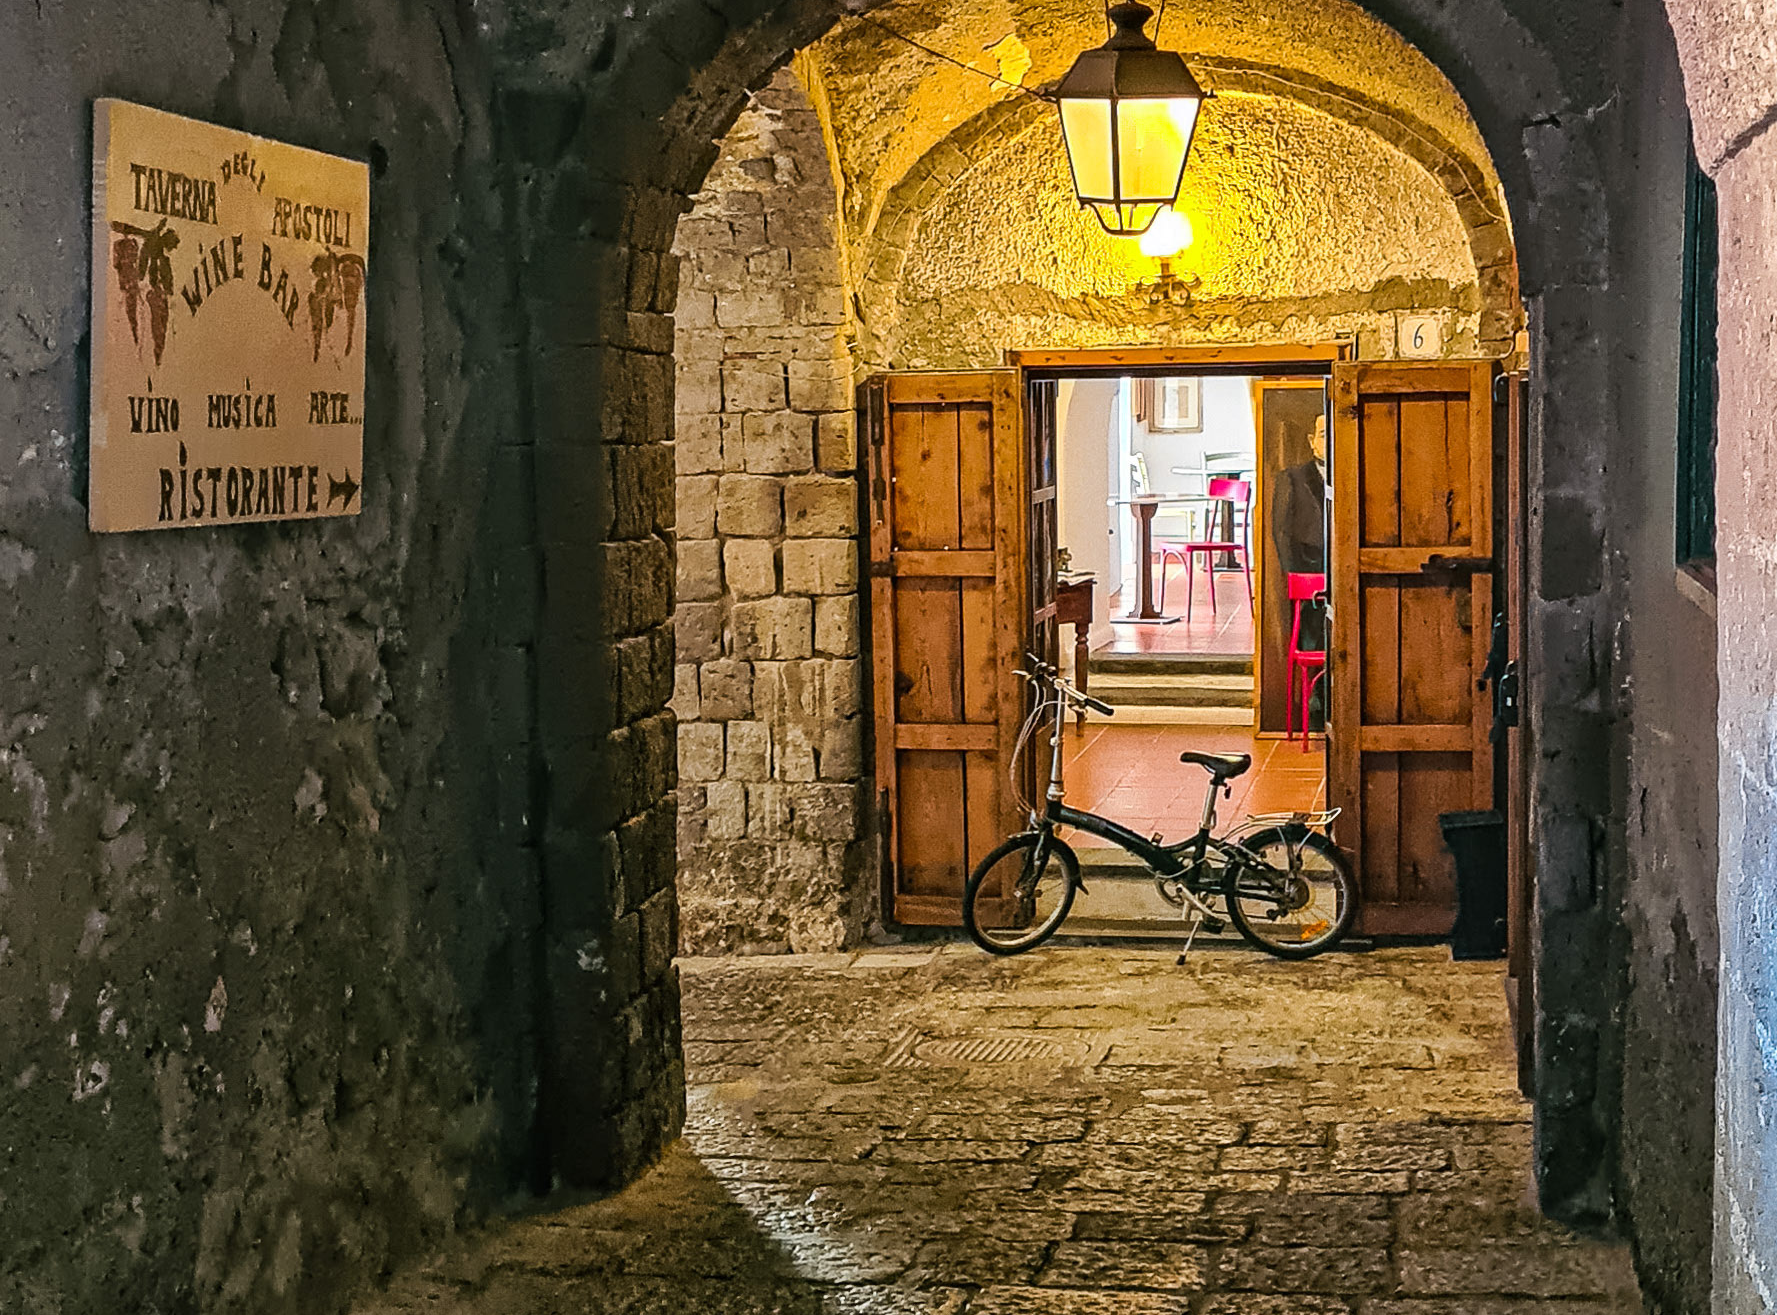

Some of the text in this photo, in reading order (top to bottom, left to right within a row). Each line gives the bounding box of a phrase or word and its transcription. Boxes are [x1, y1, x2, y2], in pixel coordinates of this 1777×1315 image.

[130, 151, 351, 248] TAVERNA DEGLI APOSTOLI
[257, 242, 299, 331] BAR
[1413, 322, 1425, 350] 6
[158, 440, 319, 523] RISTORANTE
